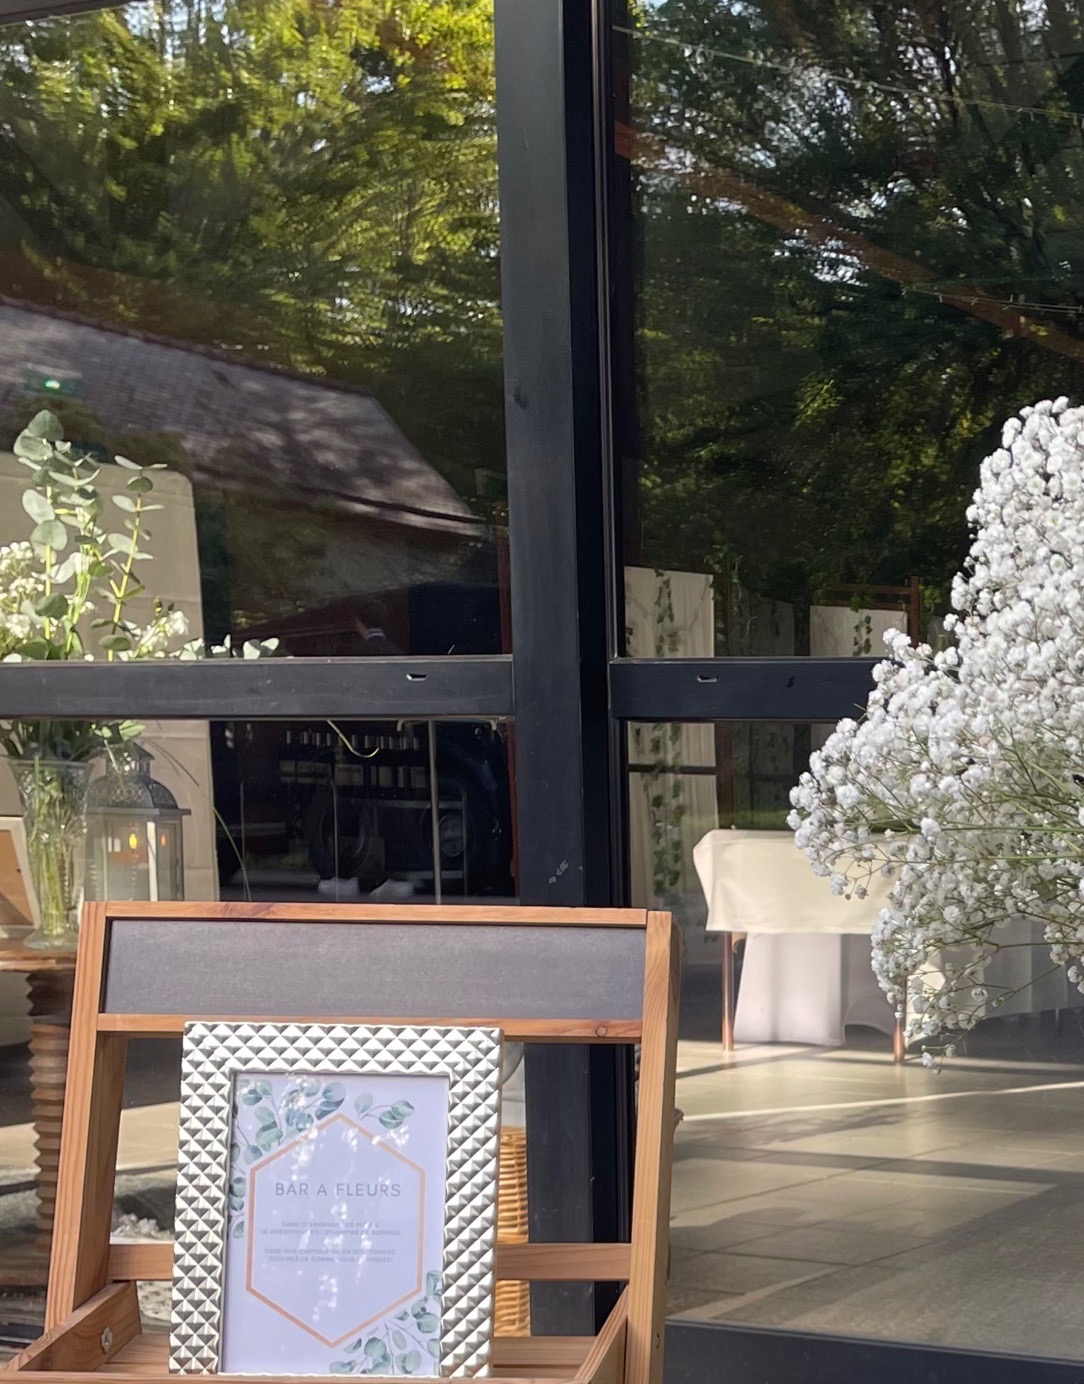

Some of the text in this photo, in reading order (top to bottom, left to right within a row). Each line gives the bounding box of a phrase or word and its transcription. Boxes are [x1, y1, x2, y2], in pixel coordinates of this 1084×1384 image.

[275, 1182, 401, 1197] BAR A FLEURS
